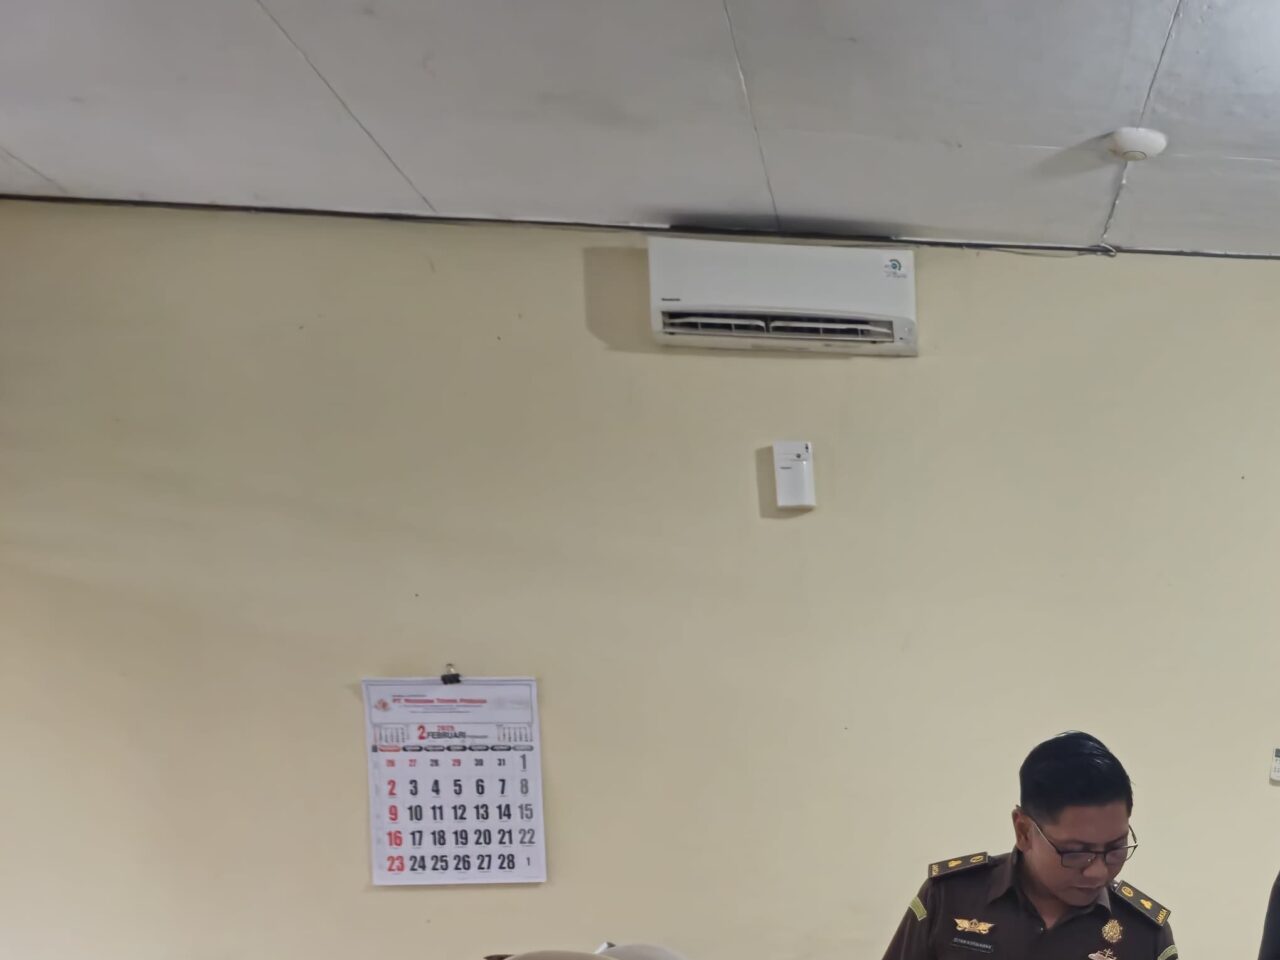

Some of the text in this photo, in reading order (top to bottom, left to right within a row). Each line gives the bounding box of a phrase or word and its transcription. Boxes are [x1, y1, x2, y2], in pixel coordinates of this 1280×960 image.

[417, 725, 427, 740] 2
[520, 754, 527, 770] 1
[388, 779, 529, 796] 2 3 4 5 6 7 8
[389, 804, 533, 821] 9 10 11 12 13 14 15
[387, 829, 536, 846] 16 17 18 19 20 21 22
[387, 856, 405, 872] 23
[410, 856, 426, 871] 24
[431, 856, 449, 871] 25
[454, 855, 471, 871] 26
[477, 855, 492, 870] 27
[498, 854, 515, 870] 28
